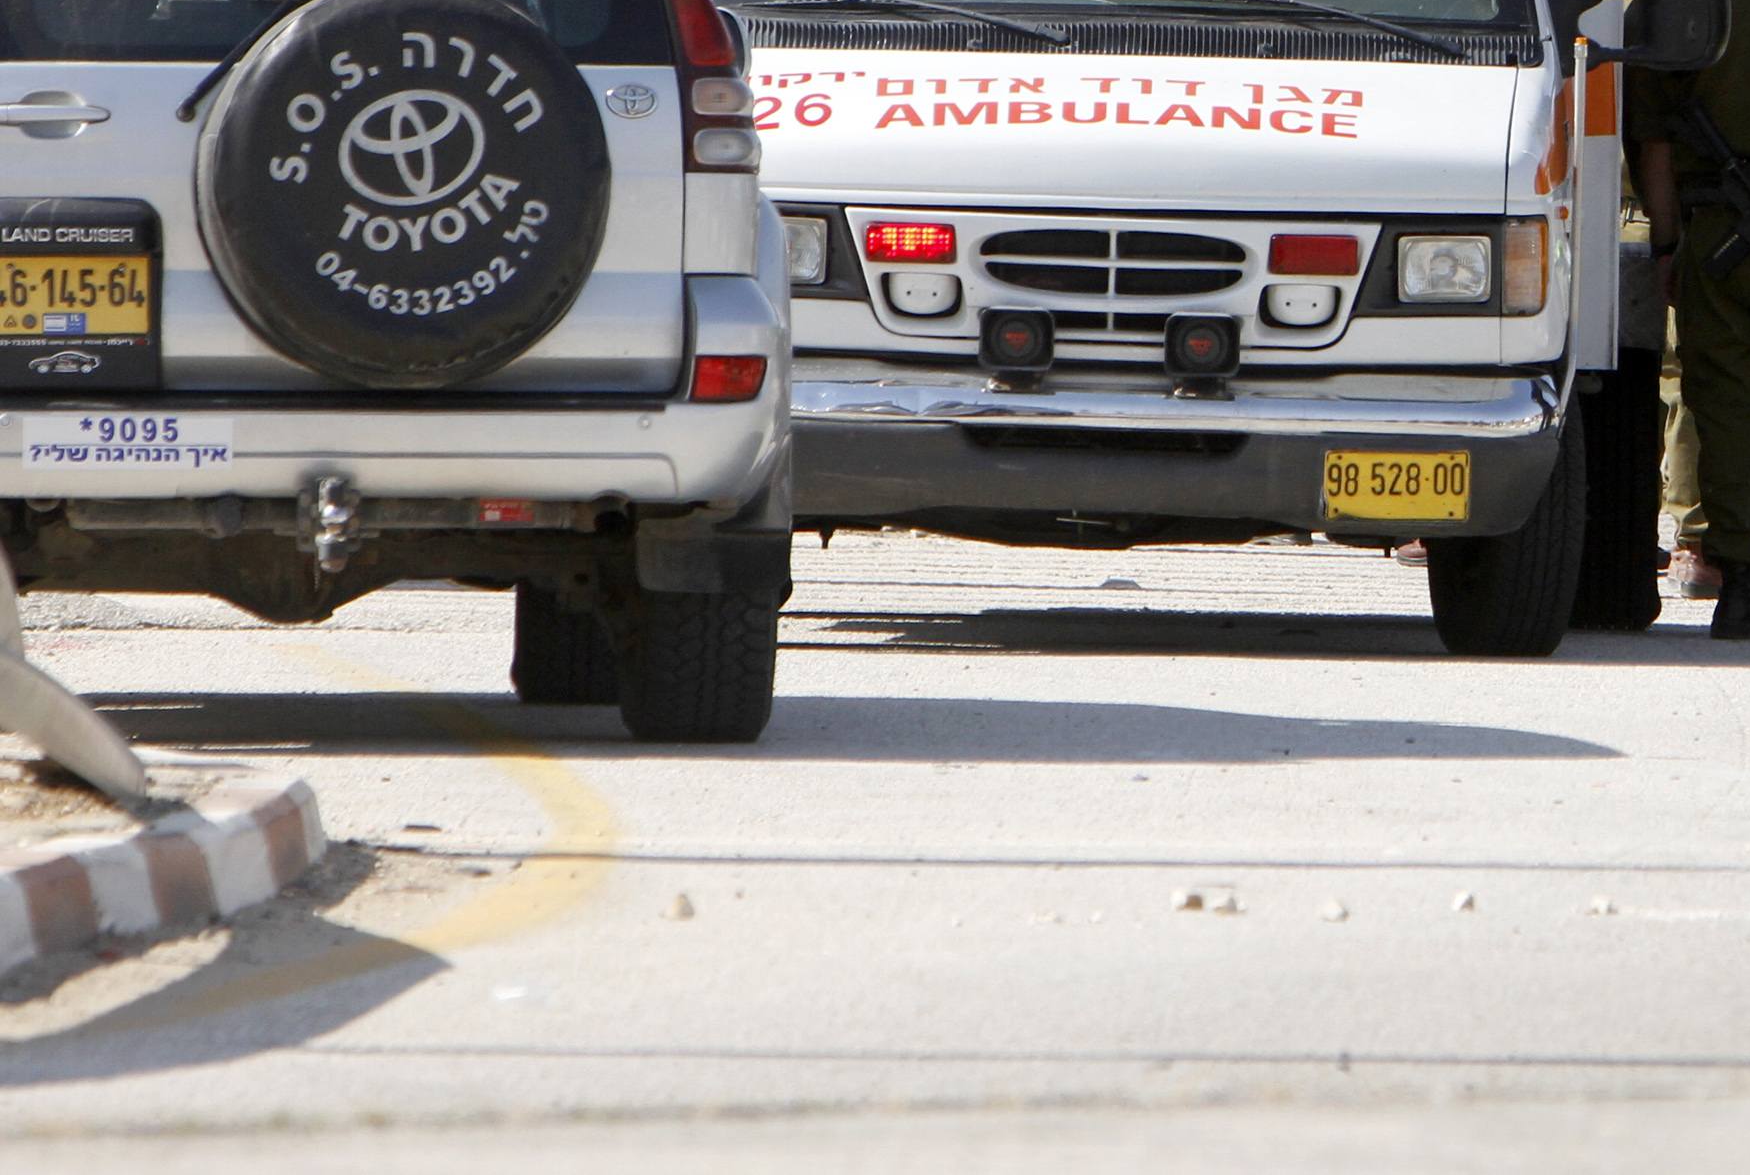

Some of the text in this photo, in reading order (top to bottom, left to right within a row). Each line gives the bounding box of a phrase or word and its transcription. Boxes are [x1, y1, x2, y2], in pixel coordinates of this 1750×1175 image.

[402, 32, 543, 133] חדרה
[748, 71, 1363, 107] מגן דוד אדום ירקו
[269, 50, 381, 184] S.O.S.
[753, 93, 1358, 138] 26 AMBULANCE
[1, 228, 133, 243] LAND CRUISER
[338, 174, 521, 252] TOYOTA
[315, 250, 518, 316] 04-6332392
[29, 444, 228, 468] איך הנהיגה שלי?
[1328, 463, 1359, 497] 98
